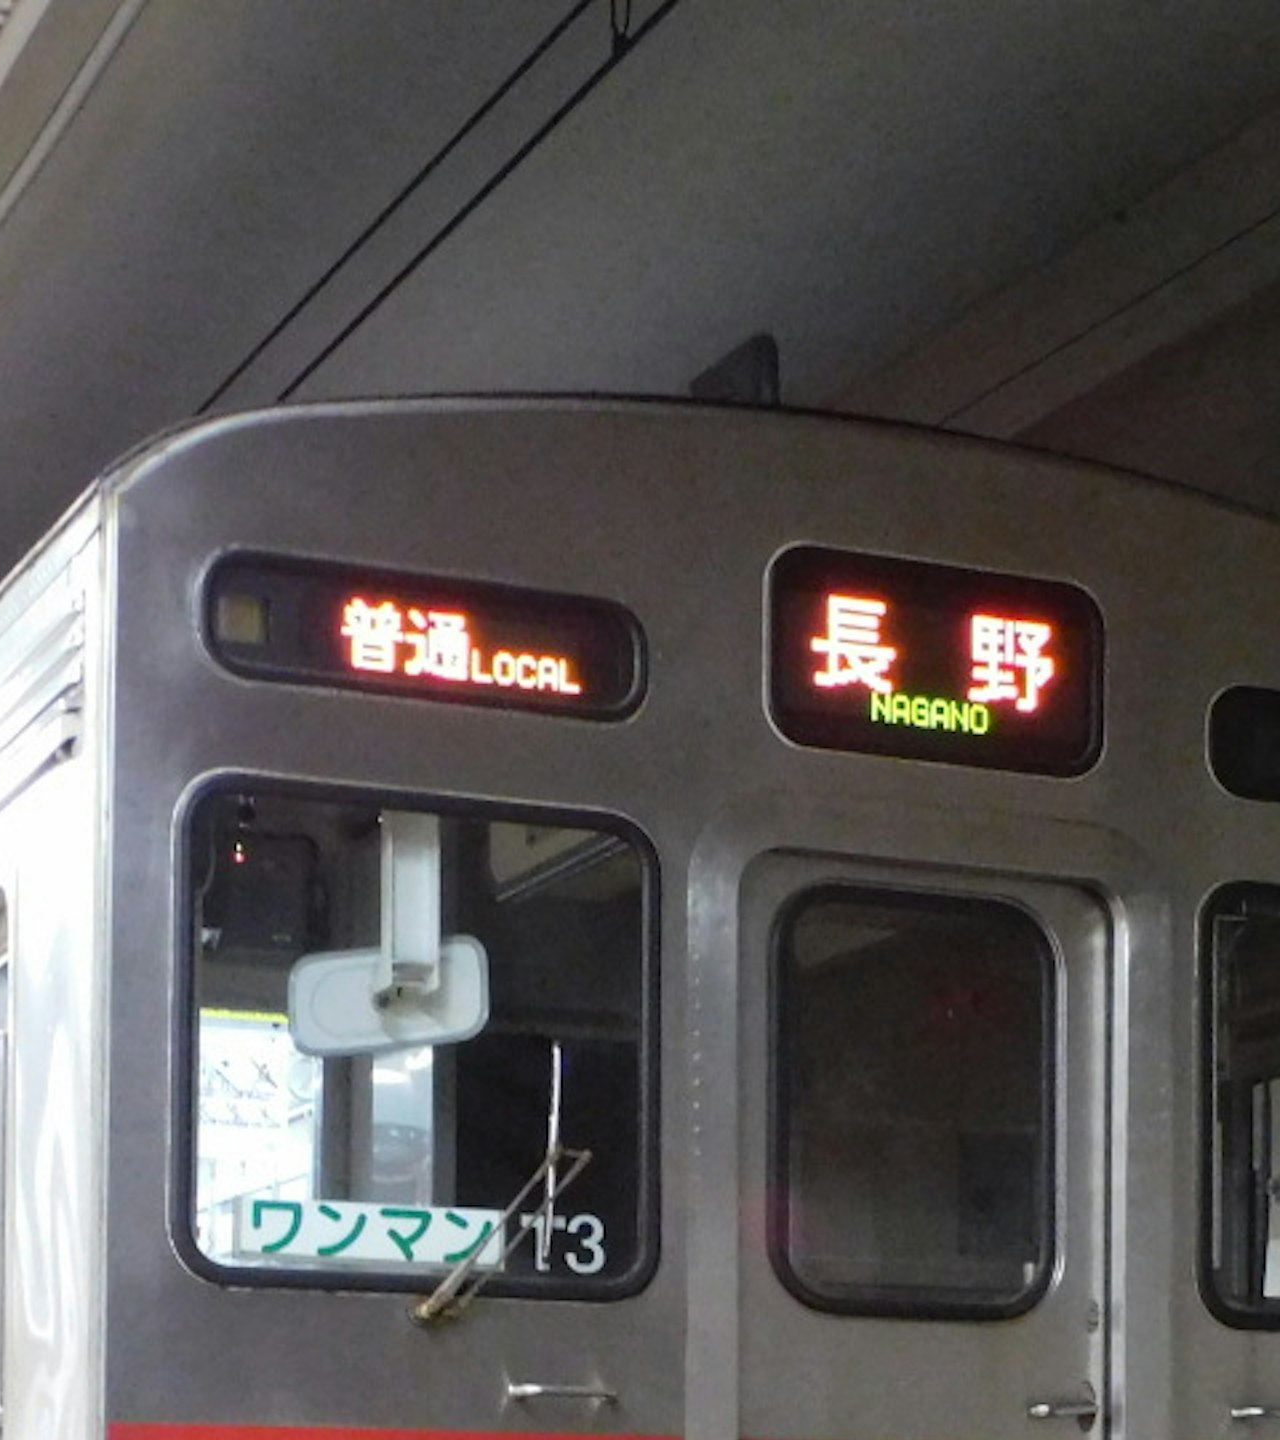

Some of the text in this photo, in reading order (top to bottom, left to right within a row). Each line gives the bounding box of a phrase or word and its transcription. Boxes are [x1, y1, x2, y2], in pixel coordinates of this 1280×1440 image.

[339, 597, 582, 695] 普通 LOCAL
[810, 593, 1054, 713] 長野
[870, 691, 990, 736] NAGANO
[253, 1200, 494, 1263] ワンマン
